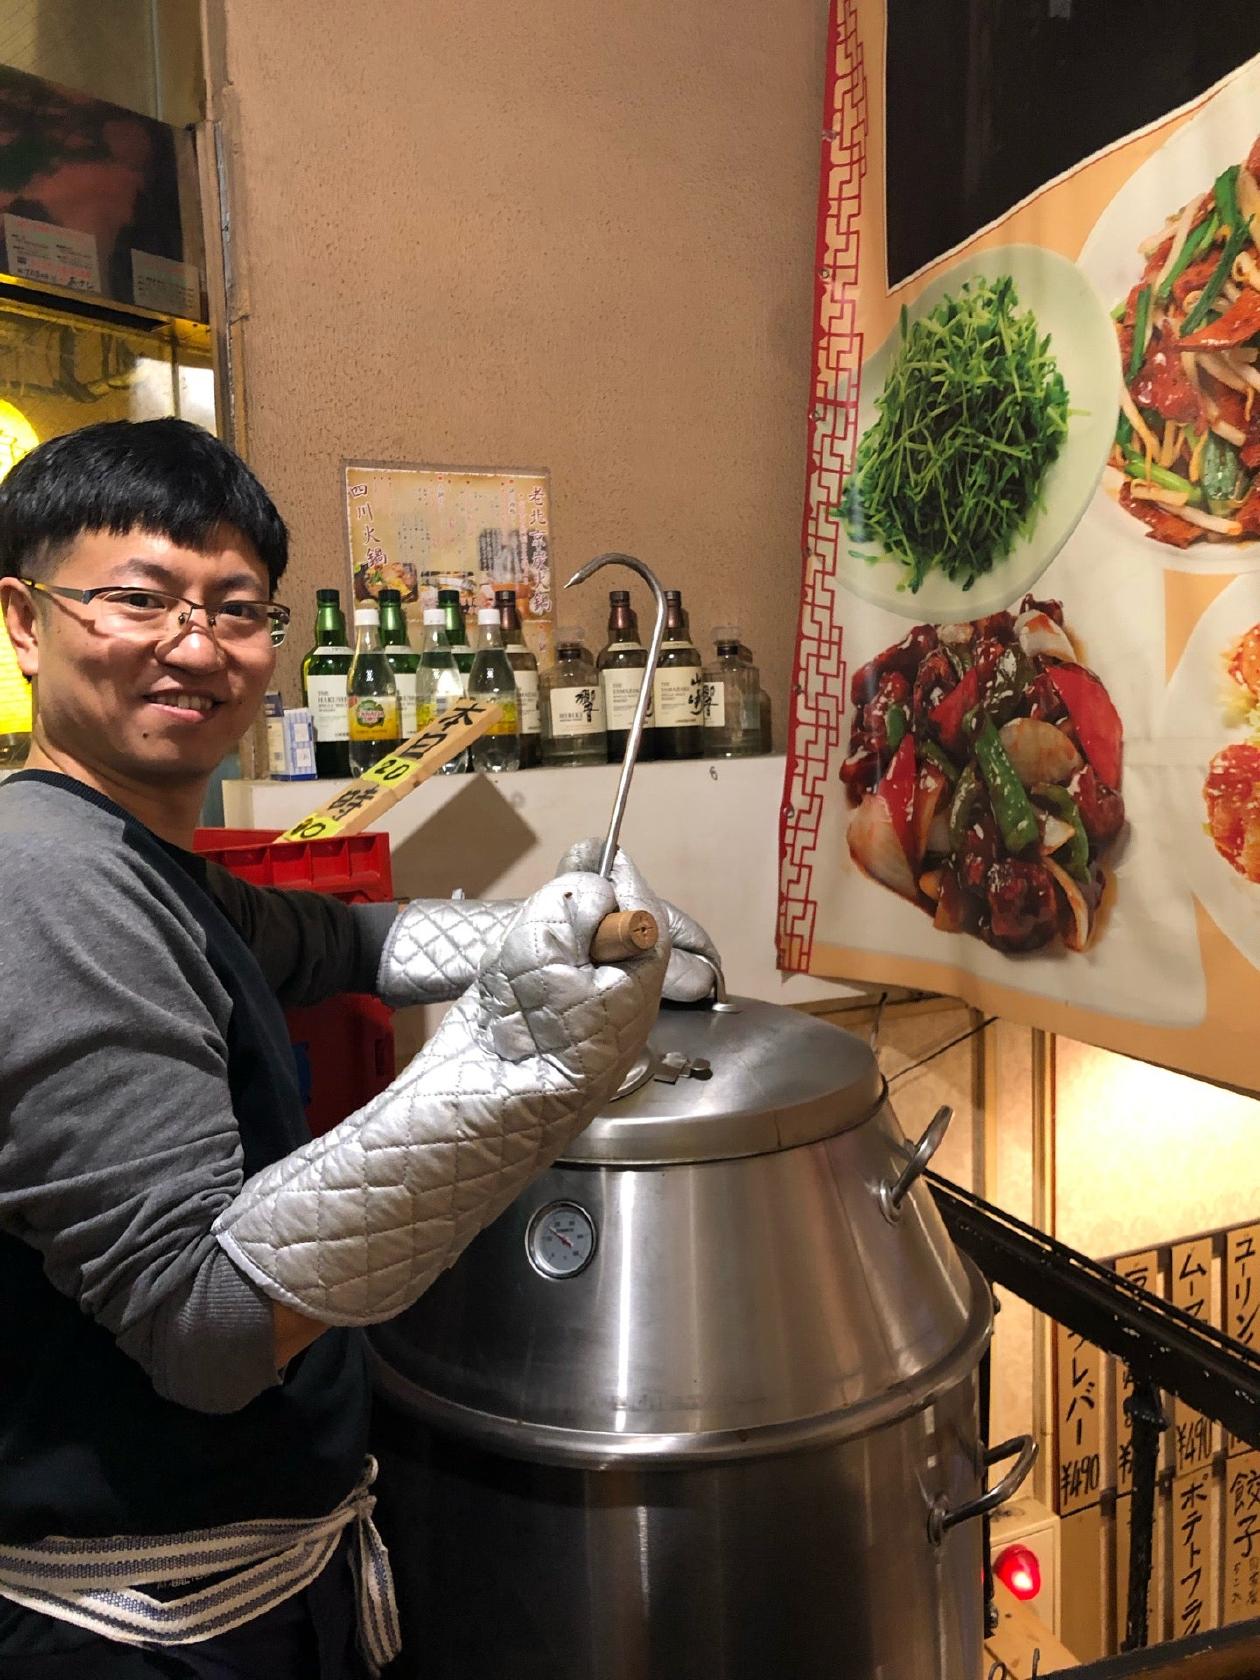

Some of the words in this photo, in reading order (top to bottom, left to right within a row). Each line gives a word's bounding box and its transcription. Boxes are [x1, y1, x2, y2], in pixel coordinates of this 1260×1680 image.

[350, 484, 387, 567] 四川火鍋
[1235, 1238, 1260, 1345] ユーリン
[1065, 1331, 1096, 1446] レバー
[1061, 1453, 1101, 1506] ¥490
